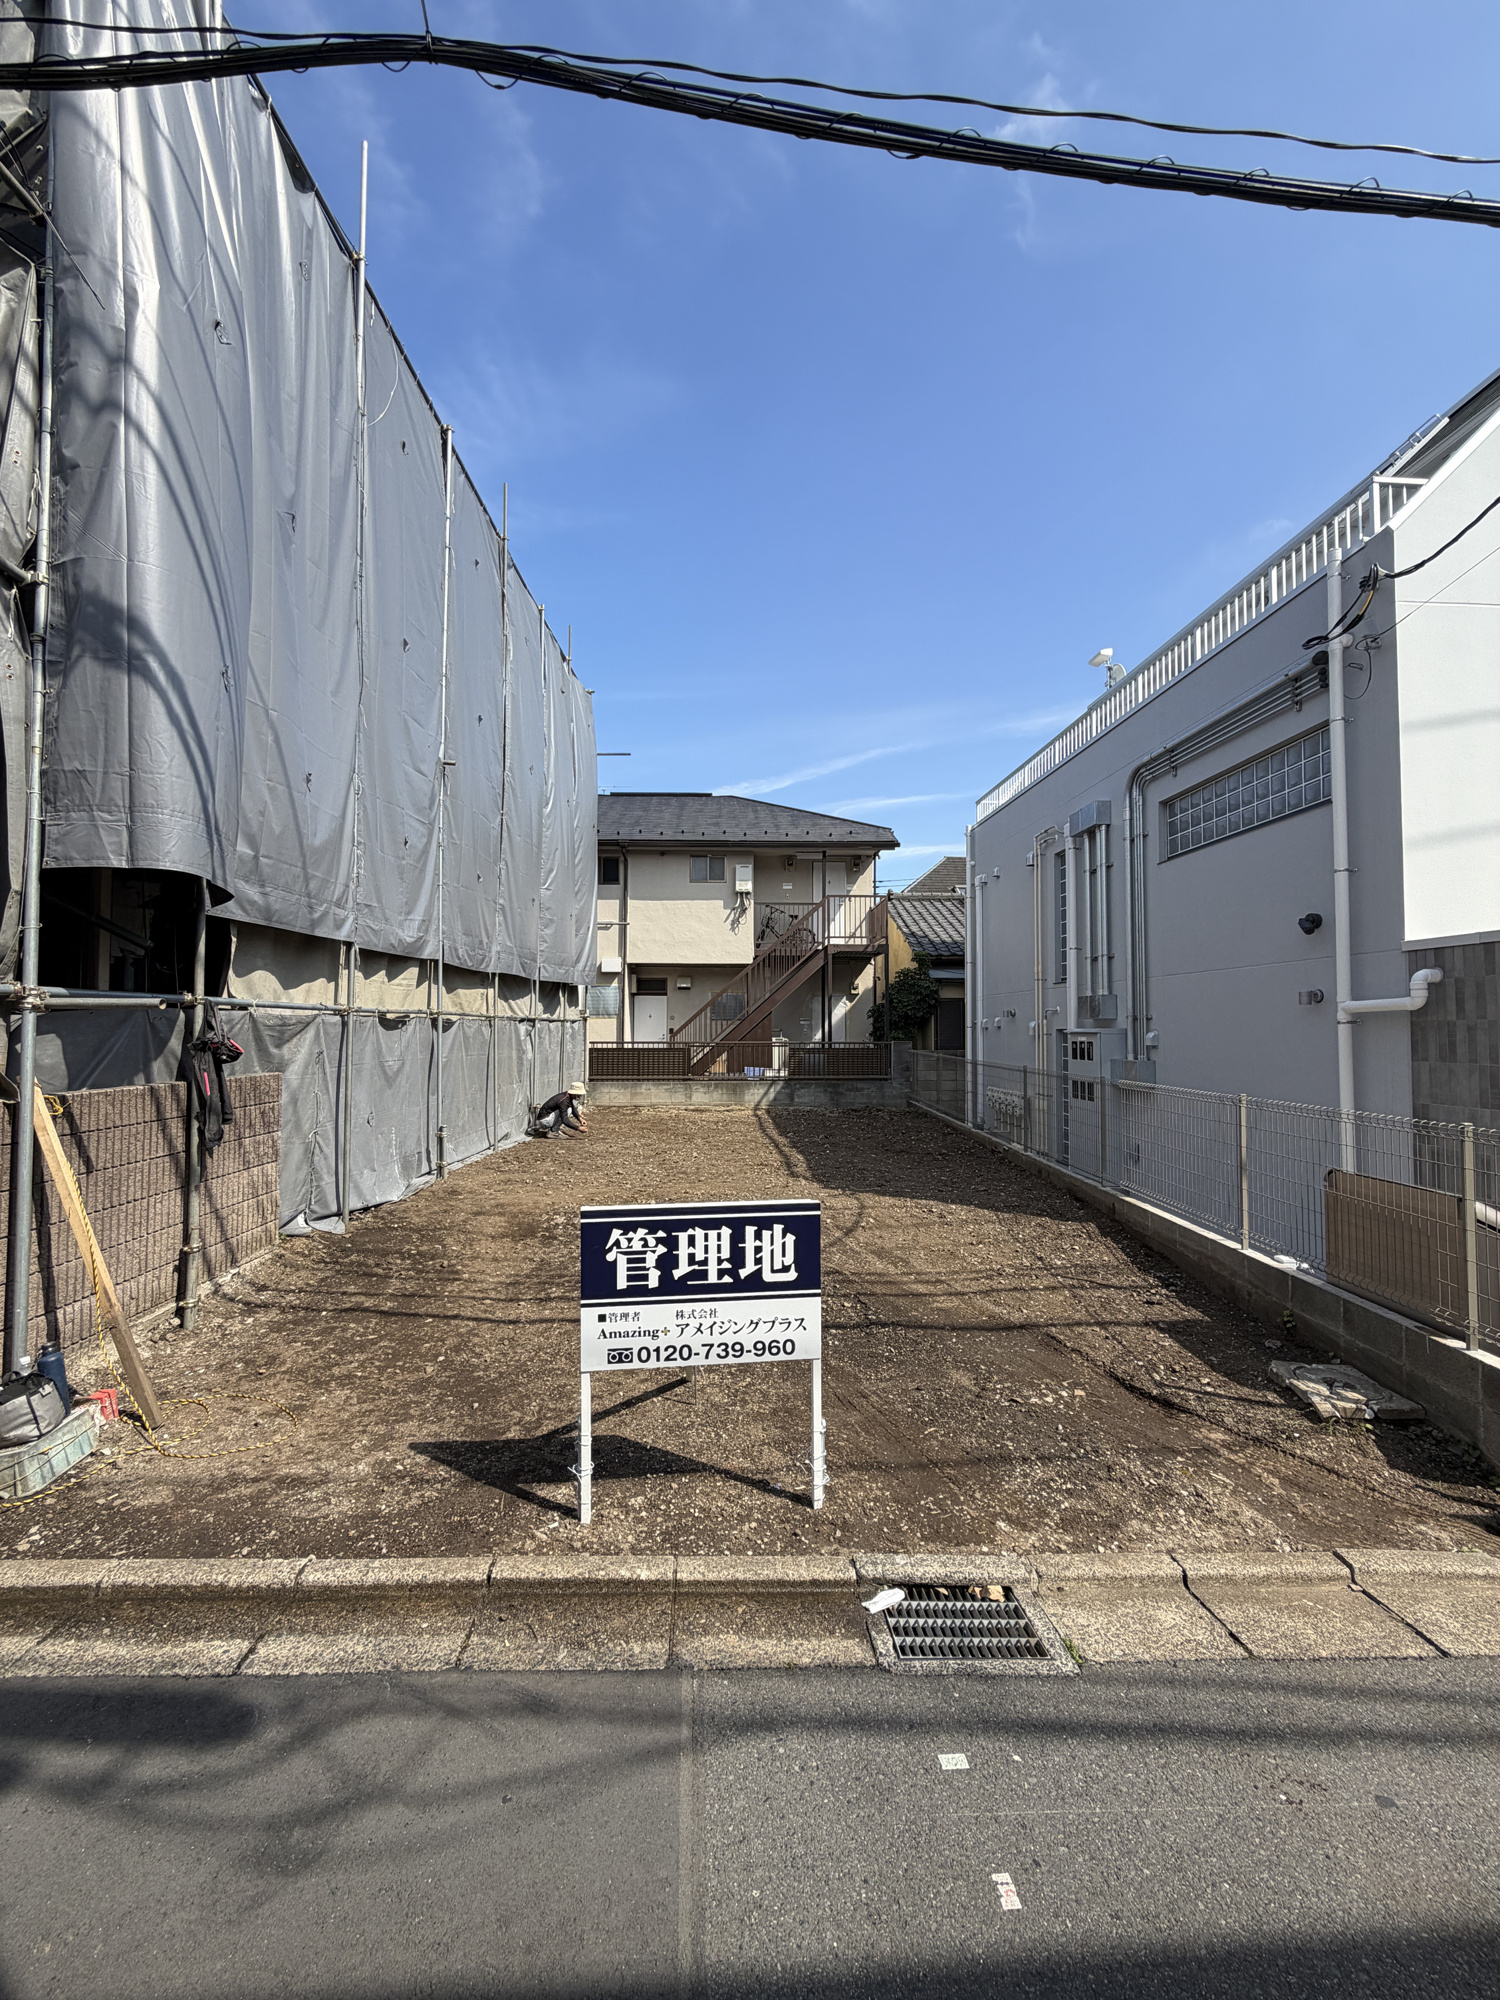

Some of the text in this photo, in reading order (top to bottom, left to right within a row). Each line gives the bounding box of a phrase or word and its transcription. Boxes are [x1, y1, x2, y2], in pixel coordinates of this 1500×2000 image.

[605, 1224, 798, 1290] 管理地
[608, 1311, 641, 1323] 管理者
[675, 1308, 719, 1320] 株式会社
[675, 1317, 807, 1338] アメイジングプラス
[637, 1338, 796, 1364] 0120-739-960
